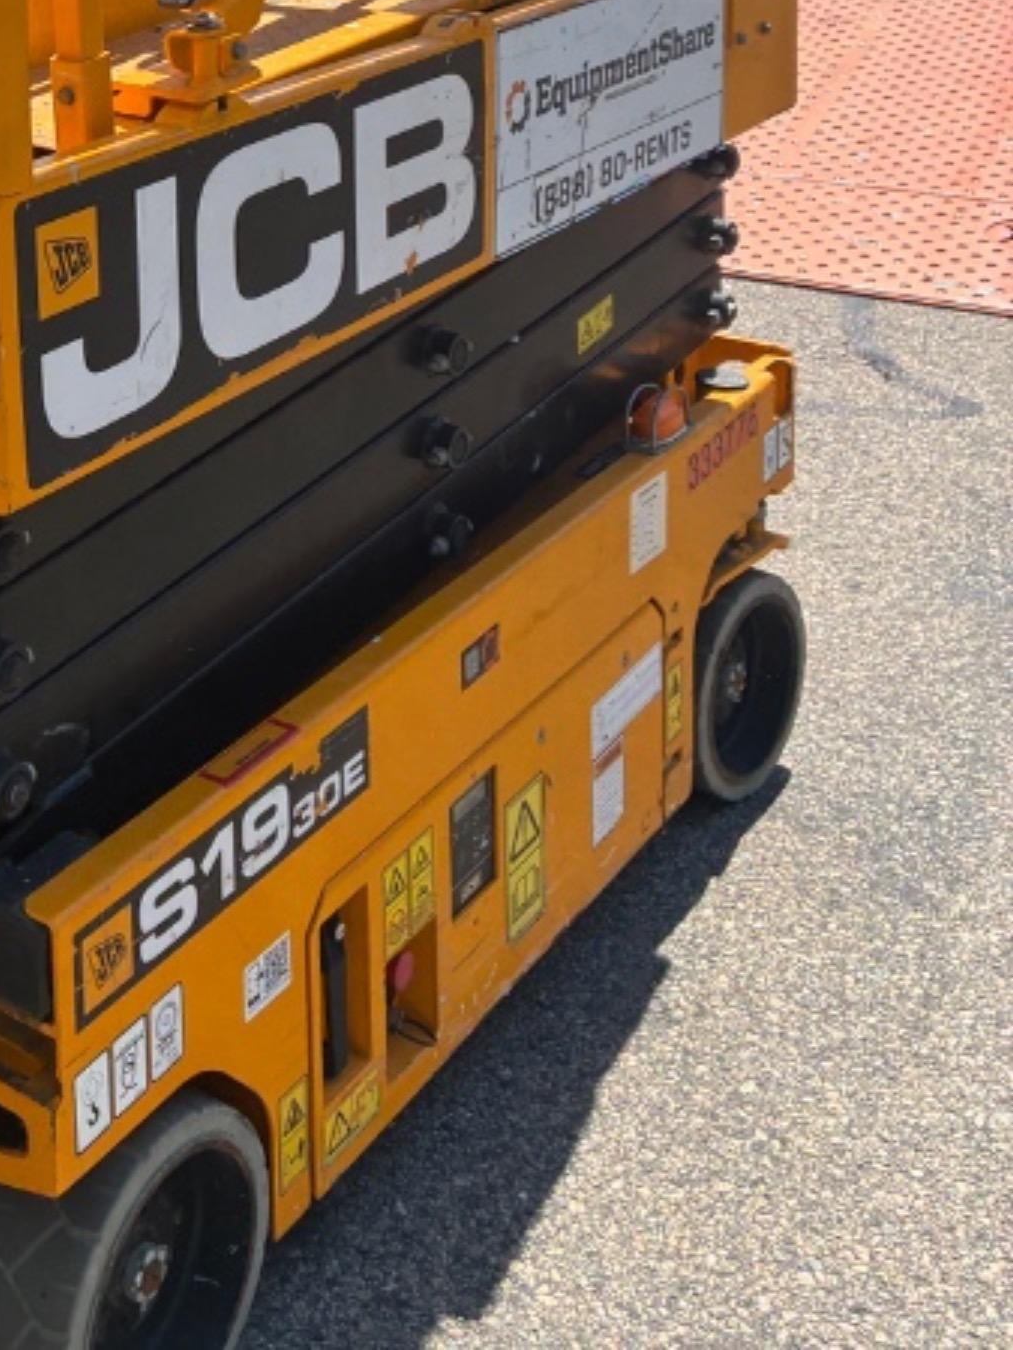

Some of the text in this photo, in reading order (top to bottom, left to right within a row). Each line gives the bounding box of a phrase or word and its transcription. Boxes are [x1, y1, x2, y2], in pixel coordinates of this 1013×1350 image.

[535, 21, 715, 118] EquipmentShare
[40, 74, 477, 439] JCB
[52, 236, 90, 282] JCB
